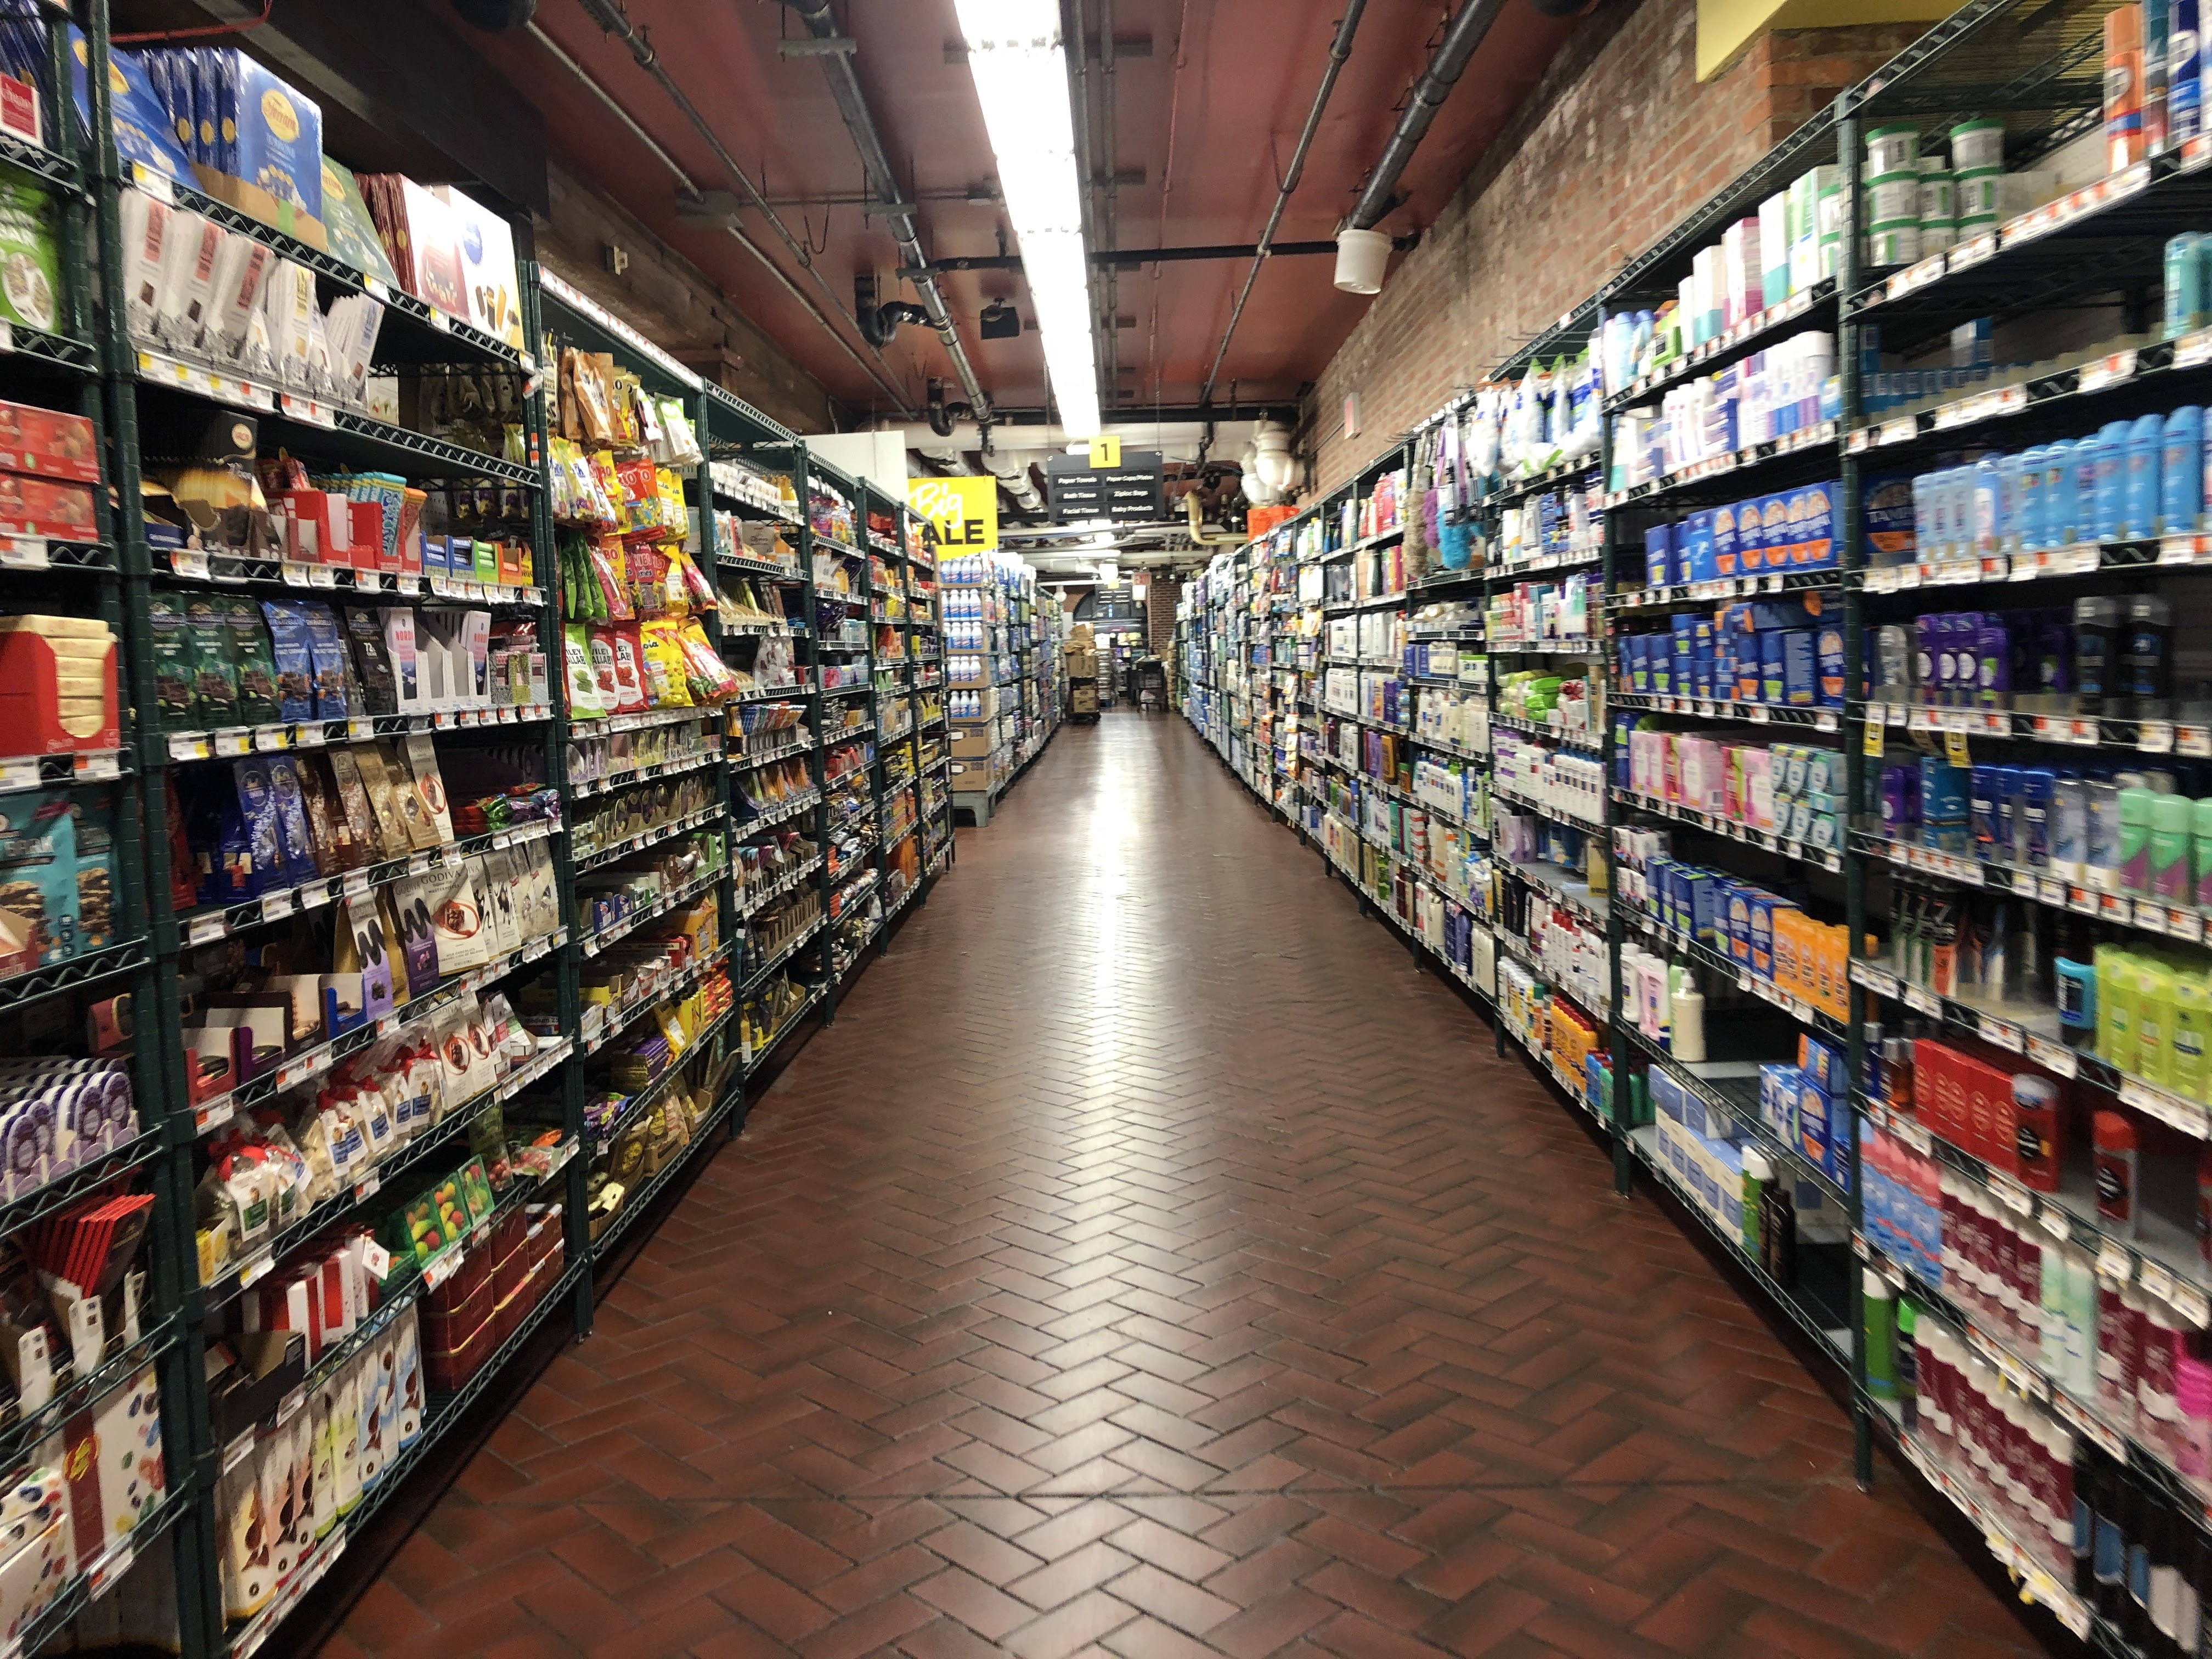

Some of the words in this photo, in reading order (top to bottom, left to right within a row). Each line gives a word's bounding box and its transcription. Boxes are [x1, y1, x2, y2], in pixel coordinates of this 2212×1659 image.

[1100, 443, 1108, 461] 1
[909, 482, 962, 529] Big
[921, 519, 986, 545] ALE
[643, 640, 659, 649] ola
[567, 656, 586, 665] ALLAB
[468, 865, 479, 874] IVA
[421, 870, 461, 884] GODIVA
